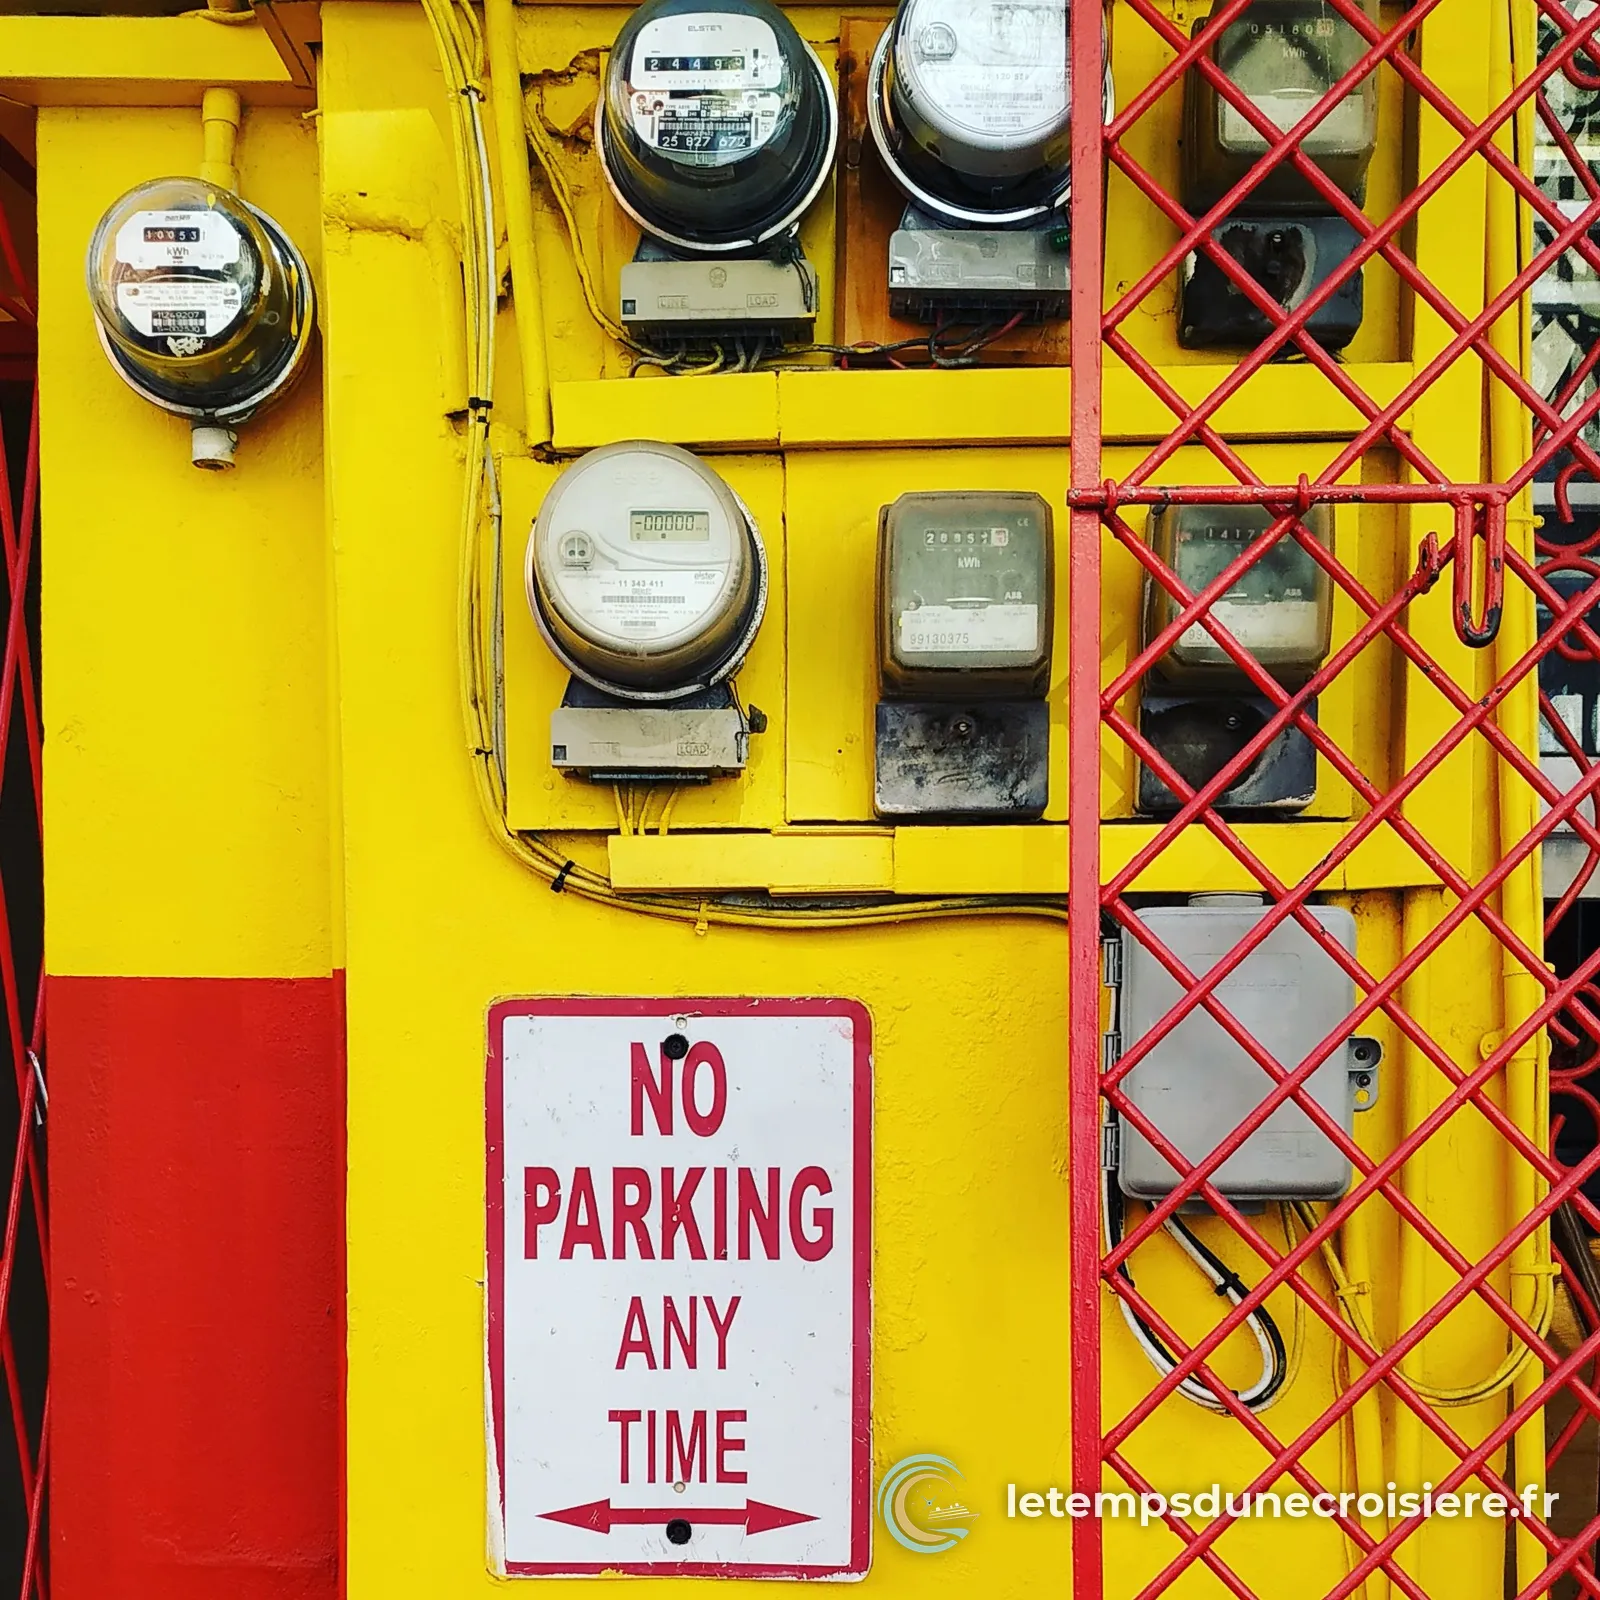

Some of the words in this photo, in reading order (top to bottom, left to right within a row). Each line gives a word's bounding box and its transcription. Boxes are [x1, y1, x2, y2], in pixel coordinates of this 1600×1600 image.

[1282, 47, 1306, 58] kWh
[662, 136, 678, 147] 25
[685, 136, 712, 147] 827
[719, 136, 746, 147] 672
[166, 246, 189, 256] kWh
[957, 556, 981, 568] kWh
[1004, 592, 1022, 600] ABB
[910, 633, 969, 644] 99130375
[630, 1040, 728, 1137] NO
[523, 1165, 835, 1262] PARKING
[615, 1295, 742, 1370] ANY
[608, 1409, 748, 1484] TIME
